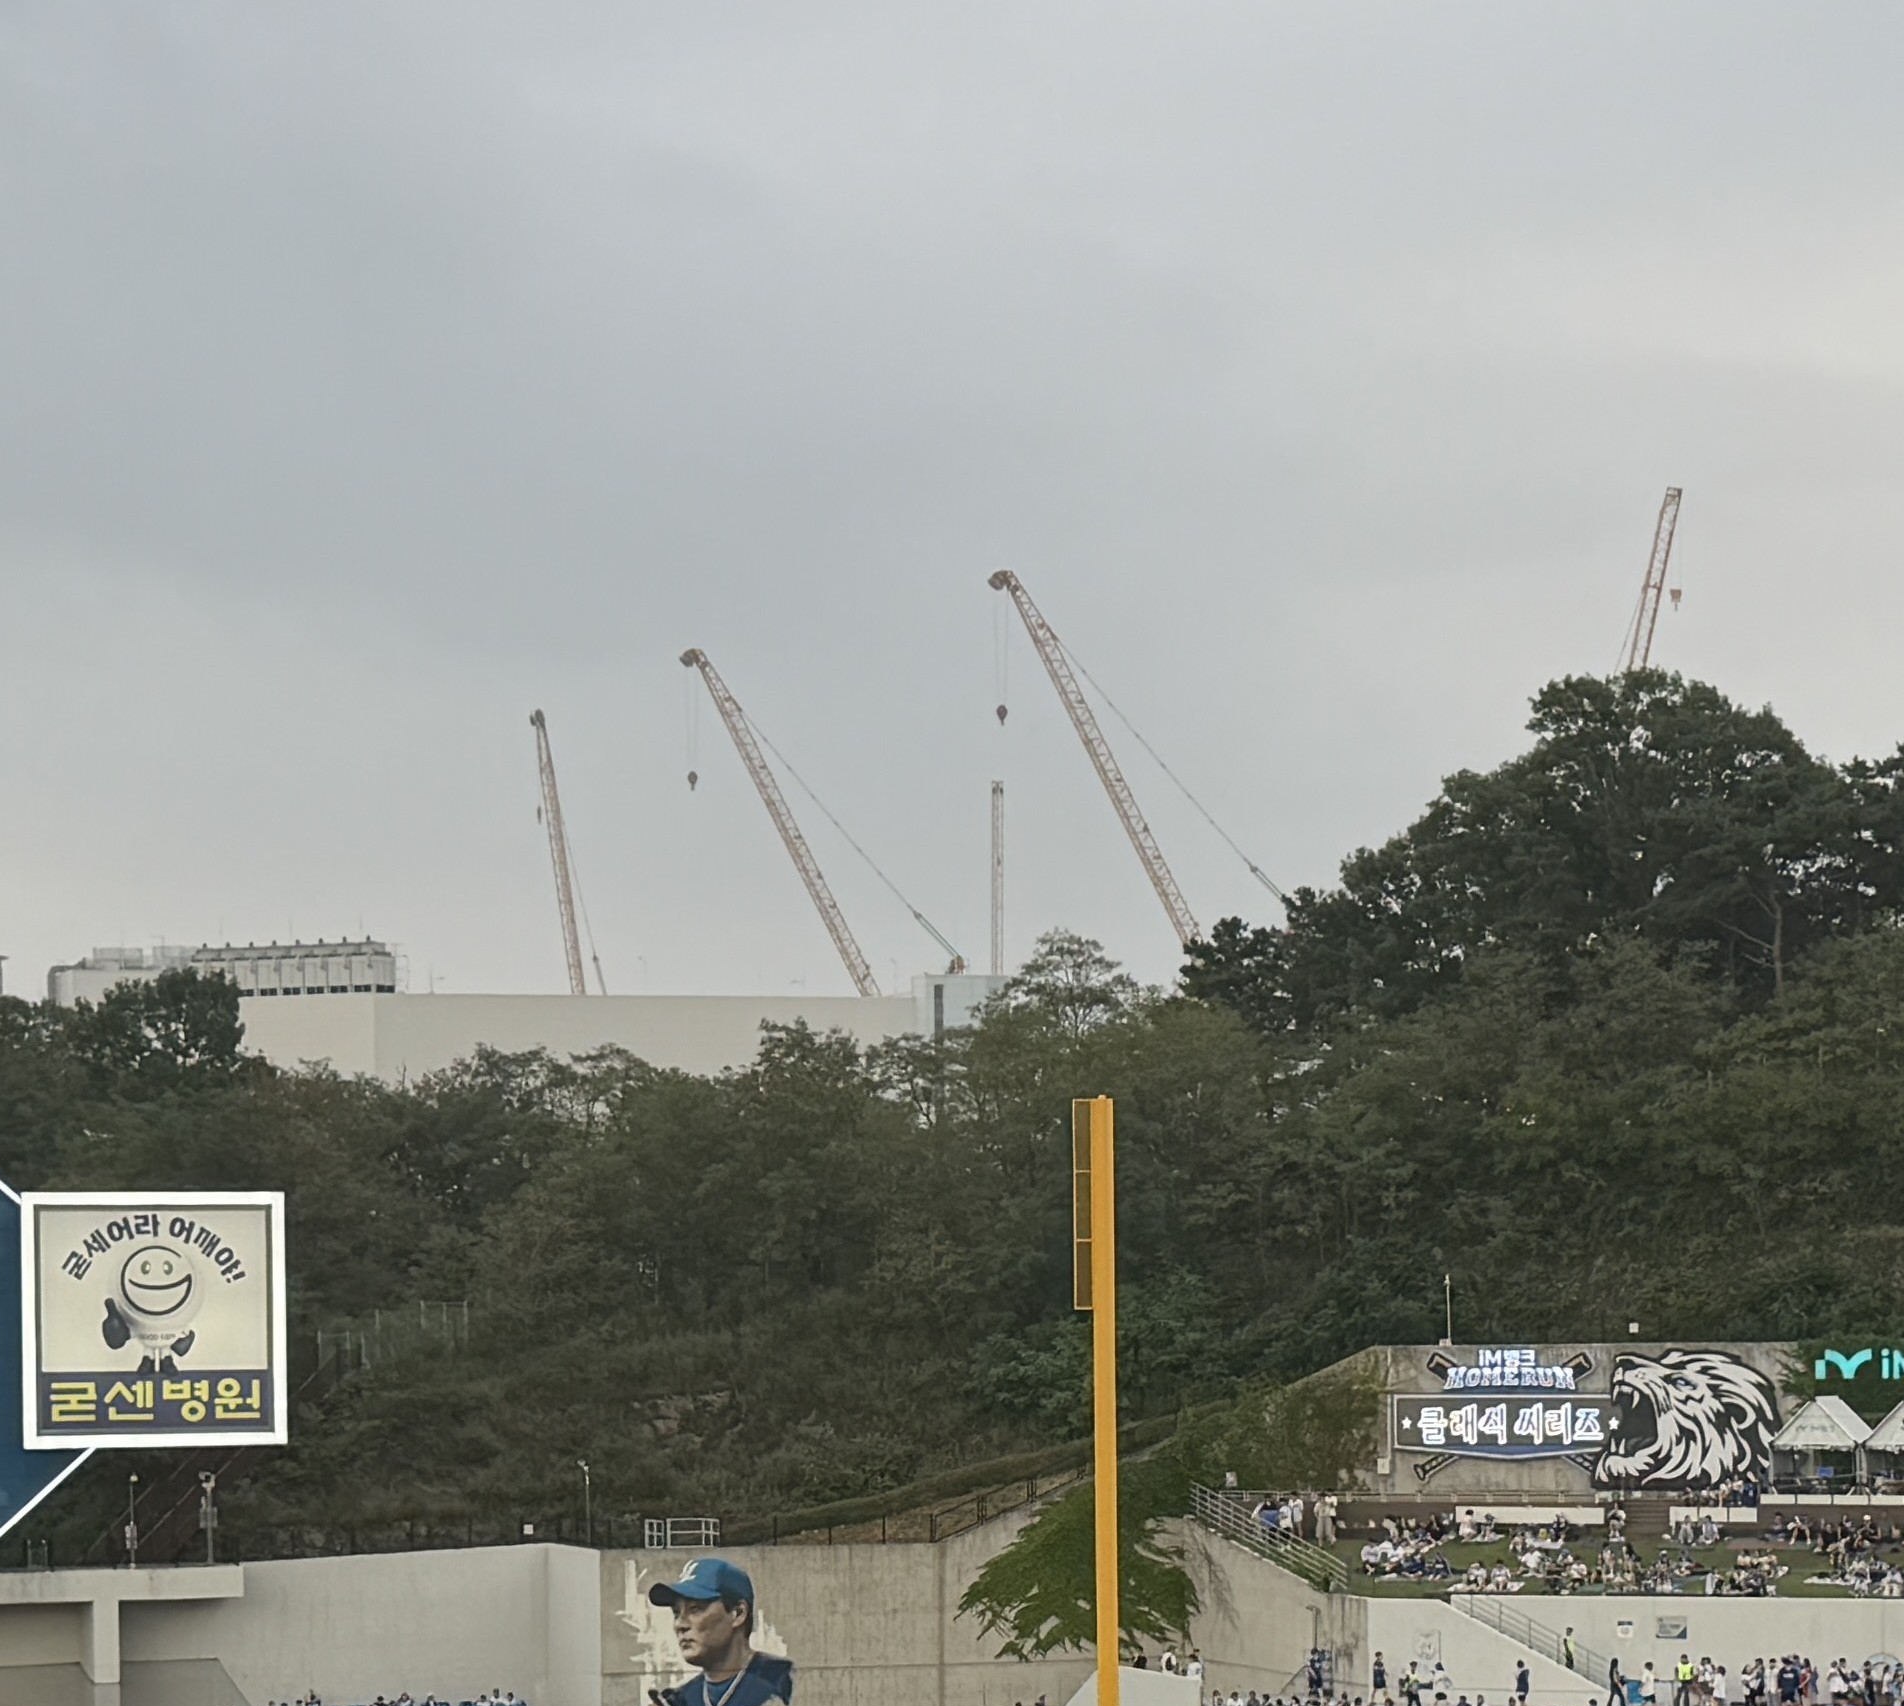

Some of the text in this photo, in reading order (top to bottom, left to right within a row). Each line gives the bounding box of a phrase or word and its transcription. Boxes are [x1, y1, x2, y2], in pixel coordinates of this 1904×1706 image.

[62, 1214, 246, 1284] 굳세어라 어깨야!
[1444, 1366, 1576, 1390] HOMERUN
